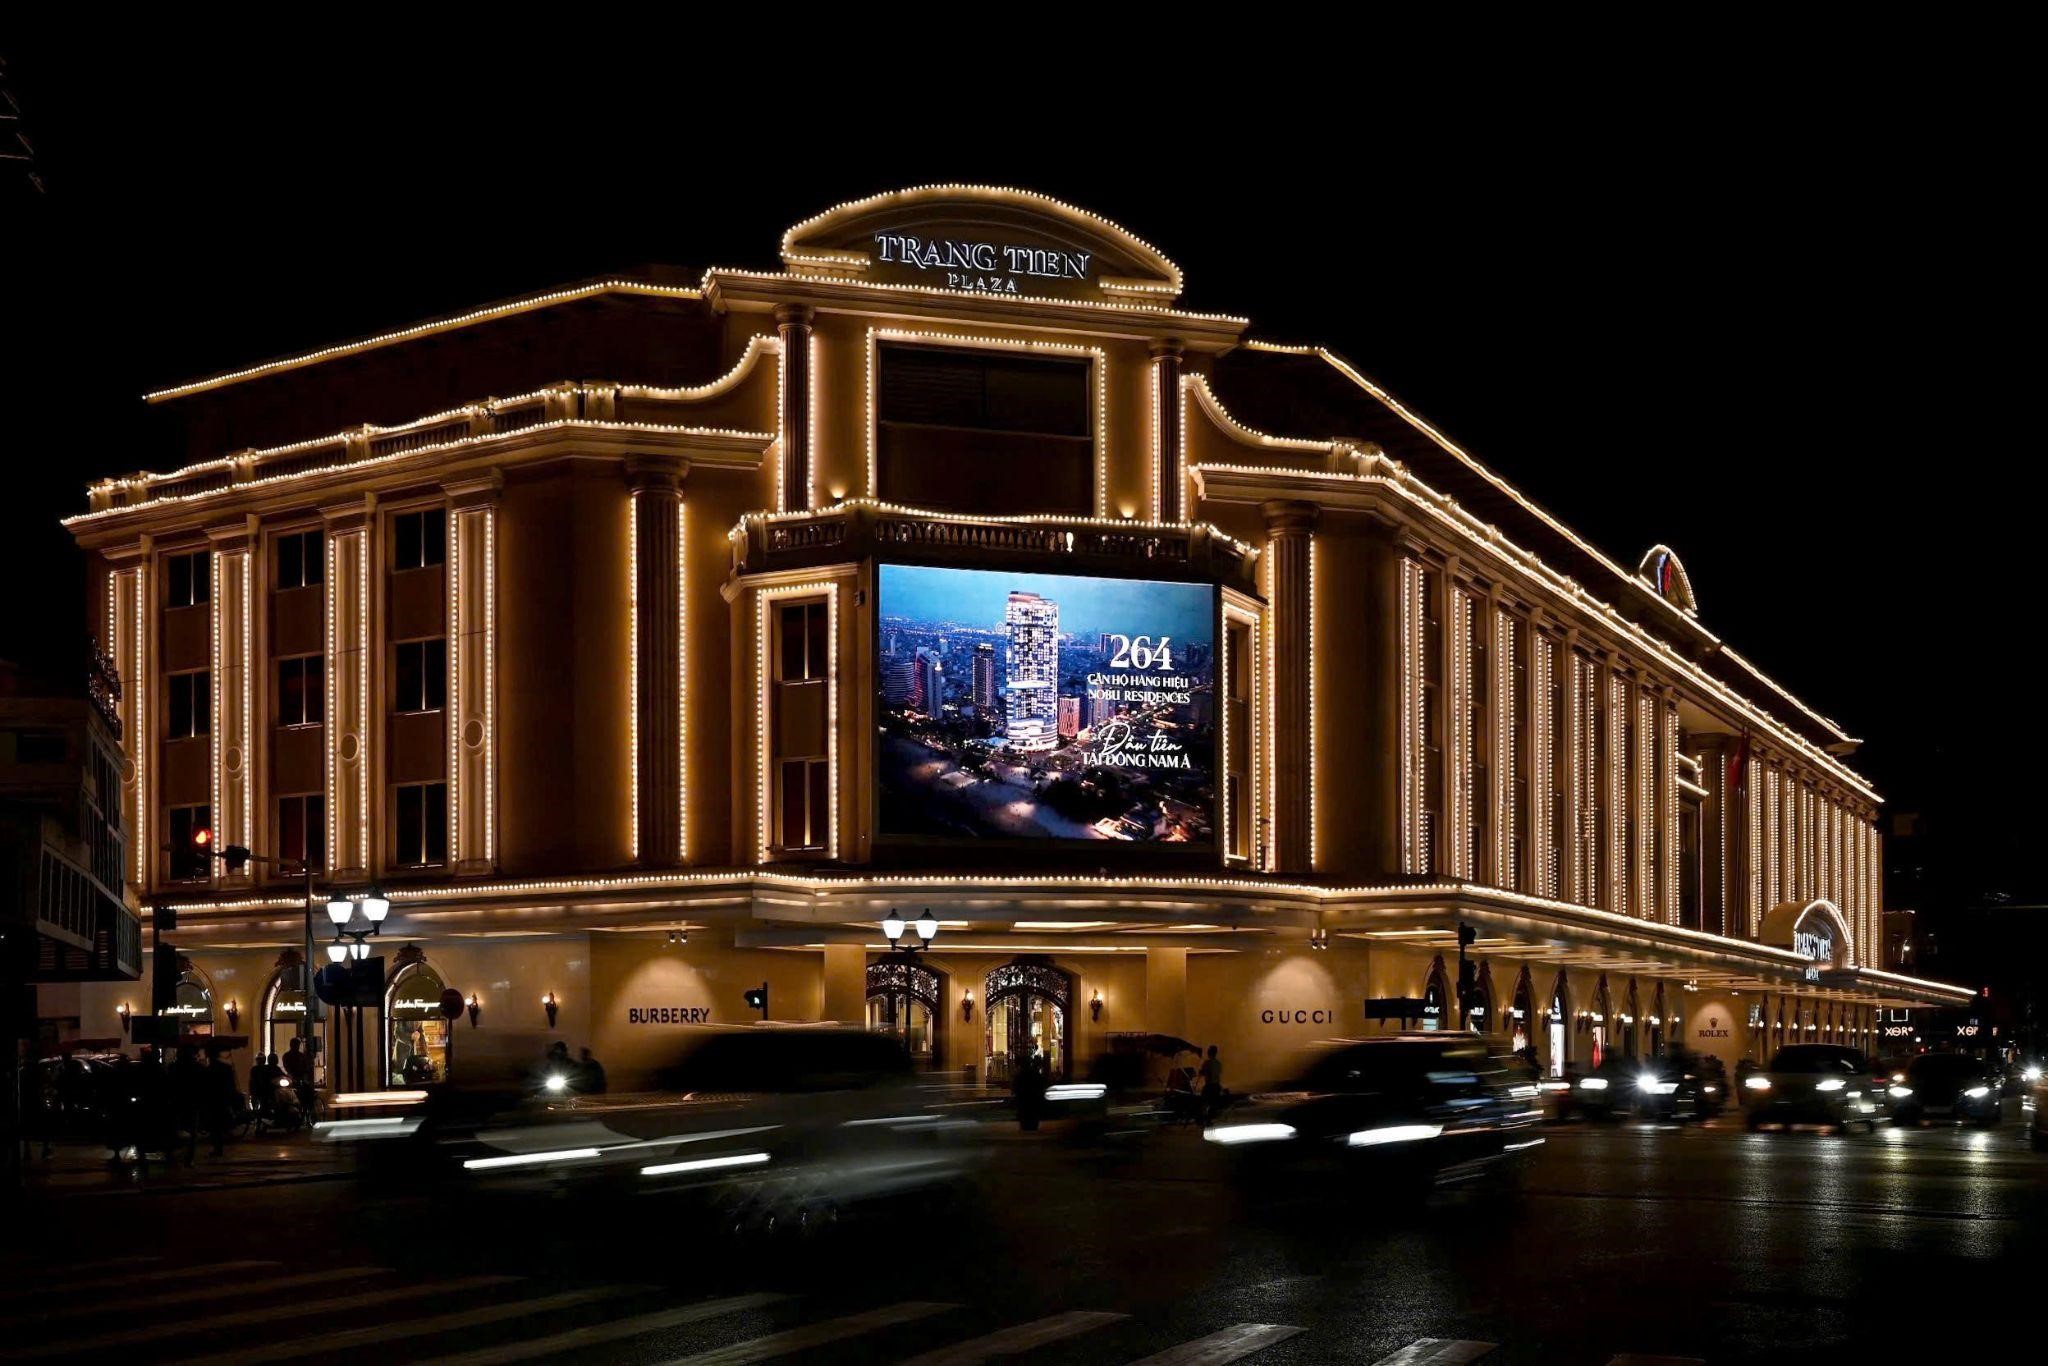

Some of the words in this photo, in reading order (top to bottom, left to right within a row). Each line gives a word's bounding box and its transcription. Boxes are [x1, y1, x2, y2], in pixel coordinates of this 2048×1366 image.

[874, 233, 997, 270] TRANG
[1004, 245, 1091, 279] TIEN
[948, 272, 1018, 293] PLAZA
[1110, 634, 1174, 670] 264
[1162, 676, 1189, 689] HIỆU
[1088, 689, 1120, 701] NOBU
[1124, 690, 1191, 703] RESIDENCES
[1148, 754, 1179, 768] NAM
[1180, 753, 1191, 769] Á
[629, 1007, 710, 1024] BURBERRY
[1261, 1010, 1332, 1024] GUCCI
[1698, 1029, 1729, 1038] ROLEX
